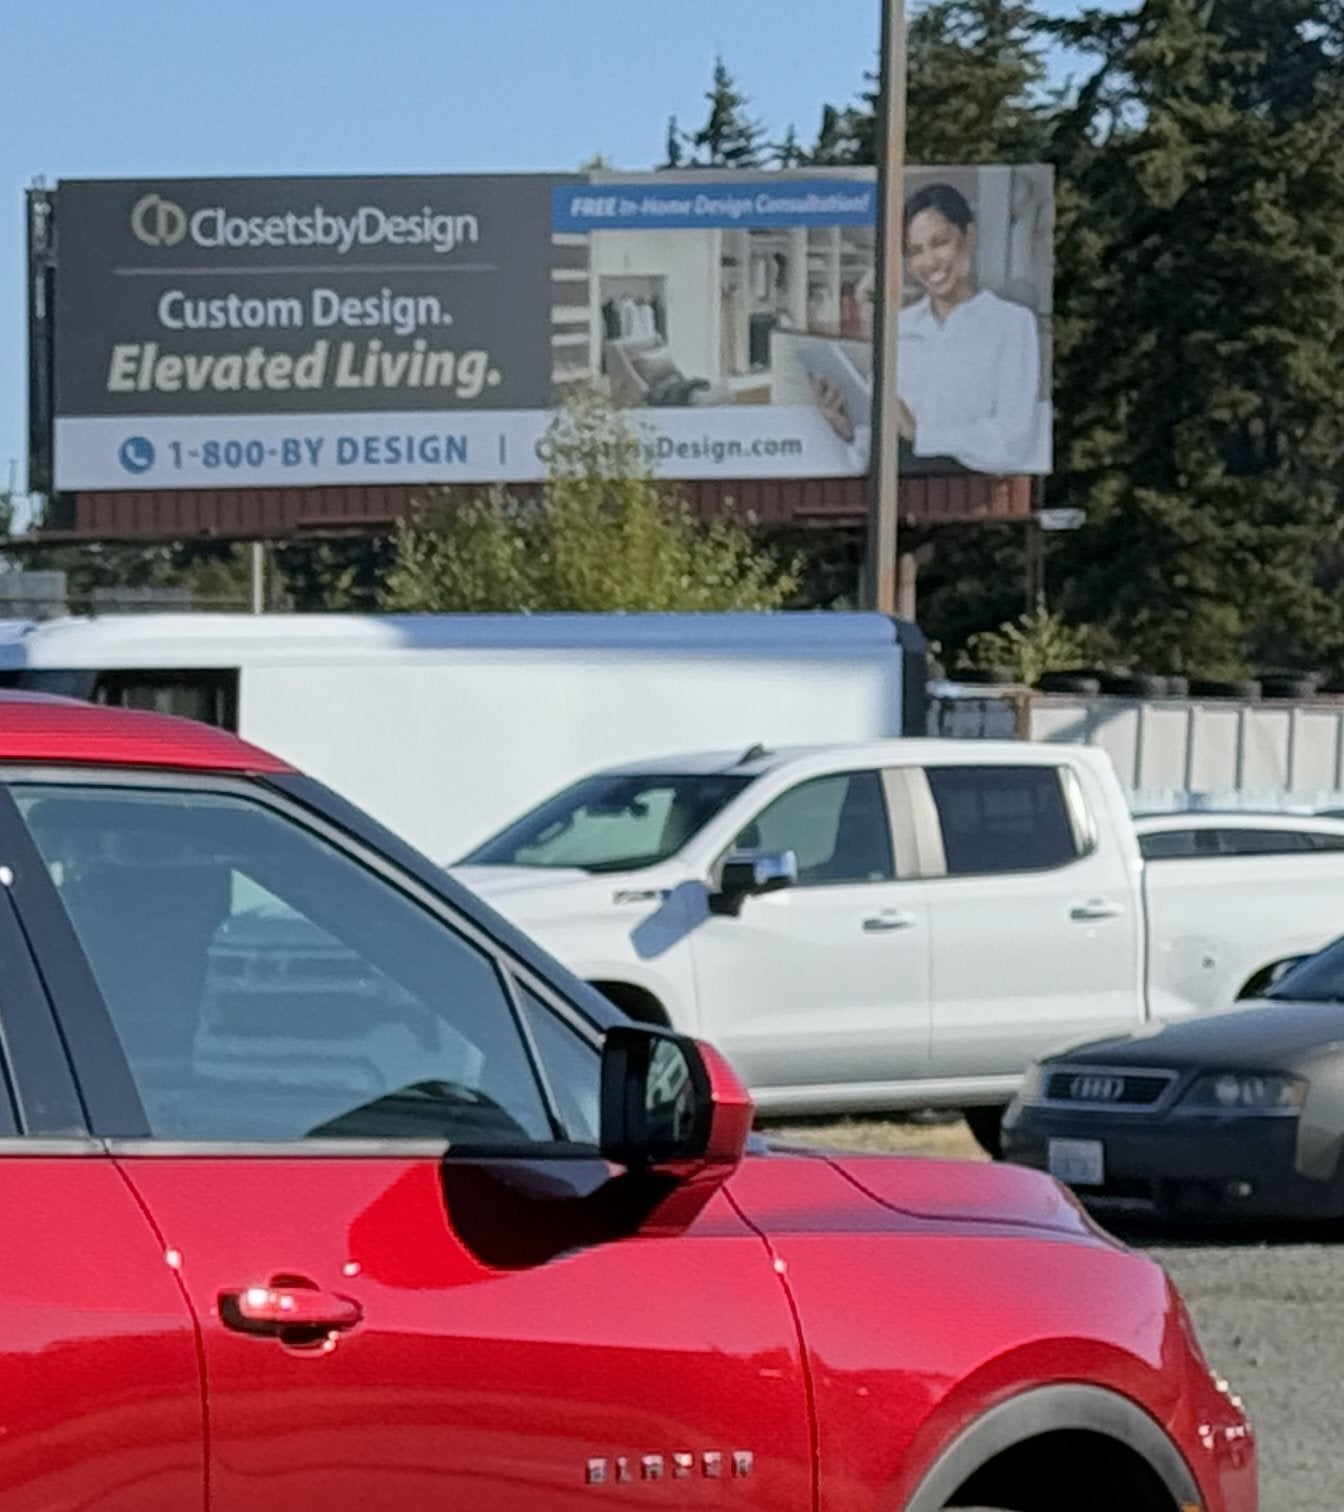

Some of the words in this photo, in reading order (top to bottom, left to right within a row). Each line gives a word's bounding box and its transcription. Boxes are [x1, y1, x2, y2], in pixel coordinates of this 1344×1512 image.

[694, 193, 752, 219] Design
[190, 206, 479, 254] ClosetsbyDesign
[158, 290, 303, 330] Custom
[313, 288, 453, 335] Design.
[107, 340, 328, 392] Elevated
[335, 339, 501, 399] Living.
[168, 438, 324, 469] 1-800-BY
[336, 435, 468, 466] DESIGN
[586, 1451, 754, 1485] BLAZER
